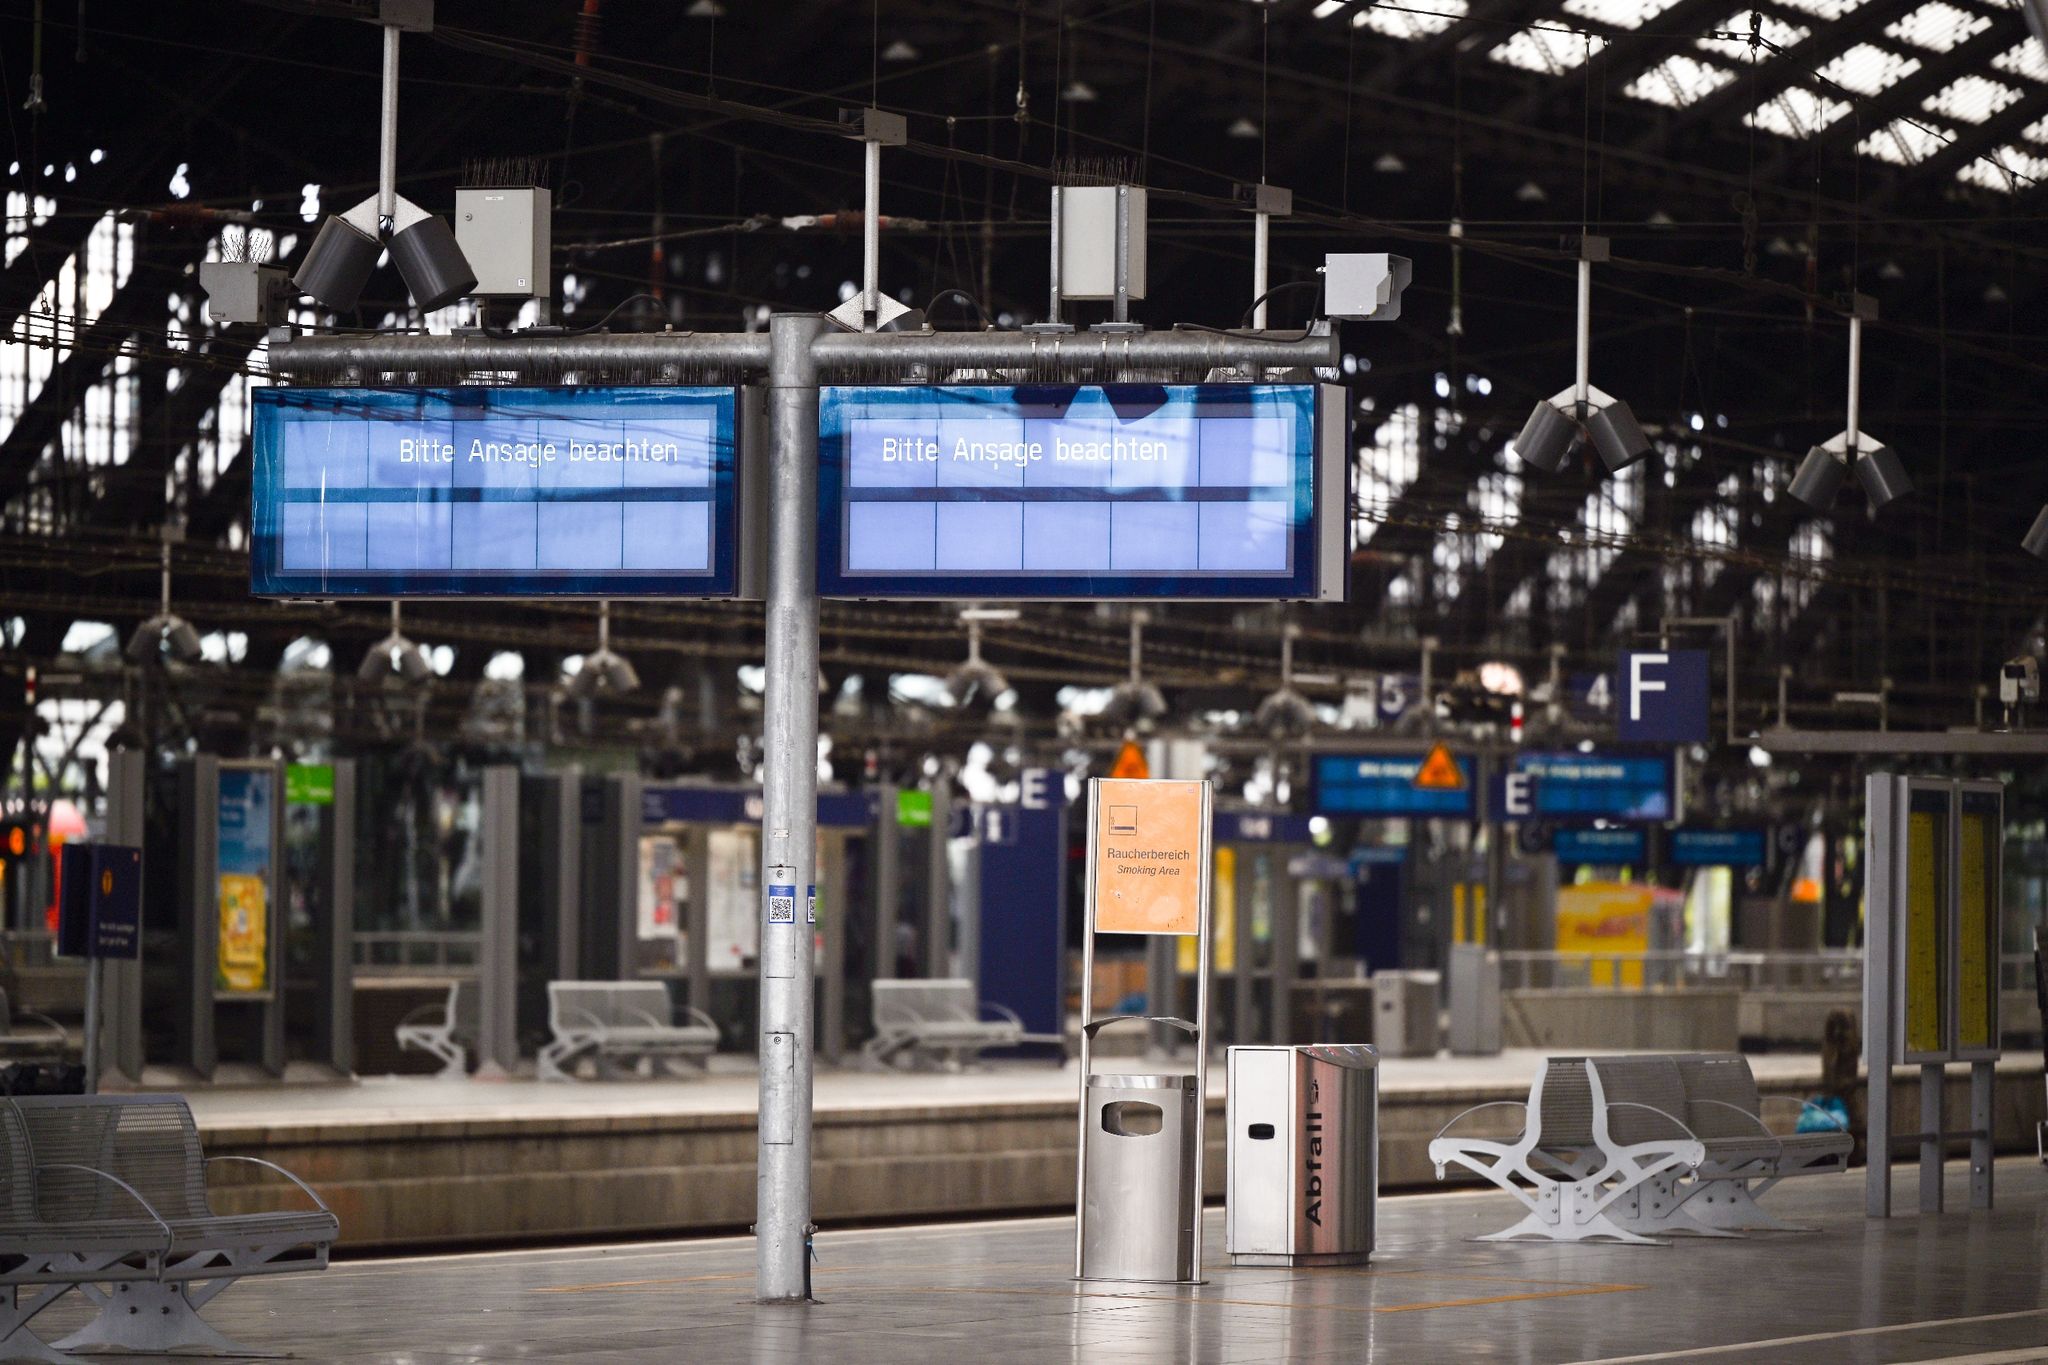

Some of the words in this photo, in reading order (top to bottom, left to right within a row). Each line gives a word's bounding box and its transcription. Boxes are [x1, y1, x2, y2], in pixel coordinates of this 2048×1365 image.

[400, 439, 454, 463] Bitte
[468, 438, 556, 468] Ansage
[569, 438, 678, 463] beachten
[882, 437, 938, 462] Bitte
[953, 437, 1043, 468] Ansage
[1056, 437, 1168, 462] beachten
[1382, 676, 1404, 713] 5
[1587, 673, 1610, 711] 4
[1629, 653, 1669, 721] F
[1021, 767, 1048, 810] E
[1505, 773, 1531, 814] E
[1107, 847, 1190, 861] Raucherbereich
[1117, 864, 1157, 877] Smoking
[1158, 866, 1180, 876] Area
[1305, 1112, 1323, 1227] Abfall
